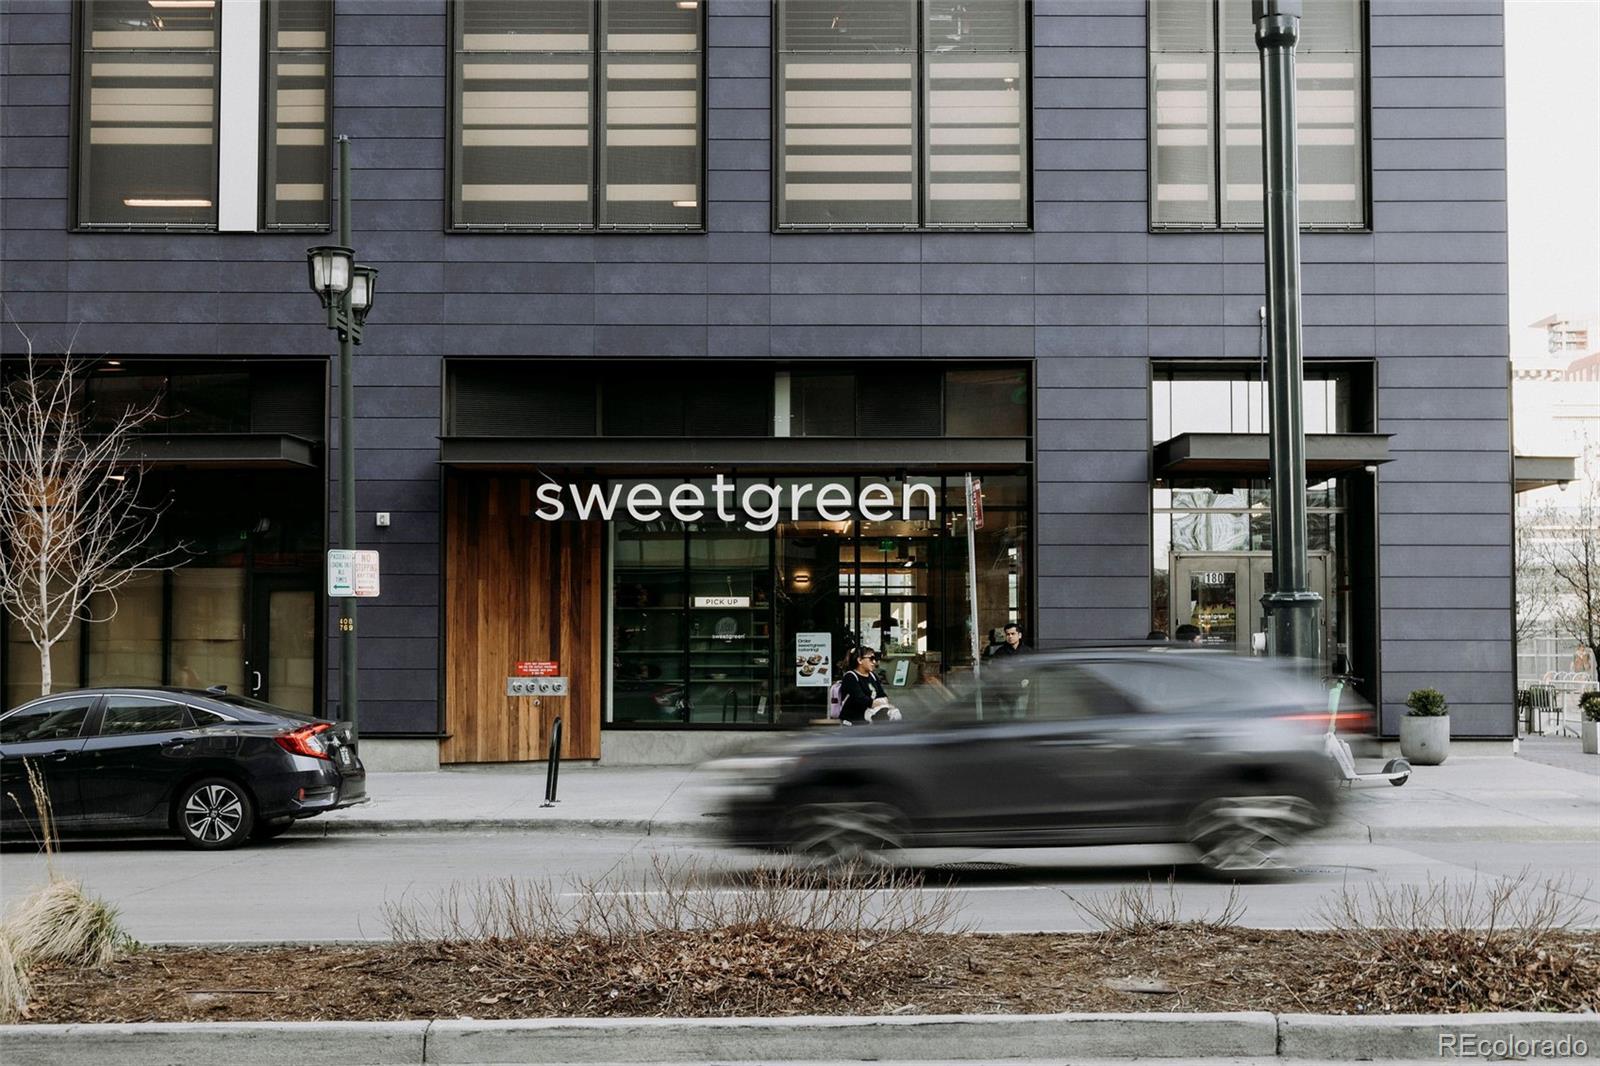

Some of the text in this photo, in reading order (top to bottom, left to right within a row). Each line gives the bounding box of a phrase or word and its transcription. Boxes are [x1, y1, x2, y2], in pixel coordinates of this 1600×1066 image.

[535, 474, 937, 532] sweetgreen
[361, 554, 372, 562] NO
[1206, 572, 1224, 584] 180
